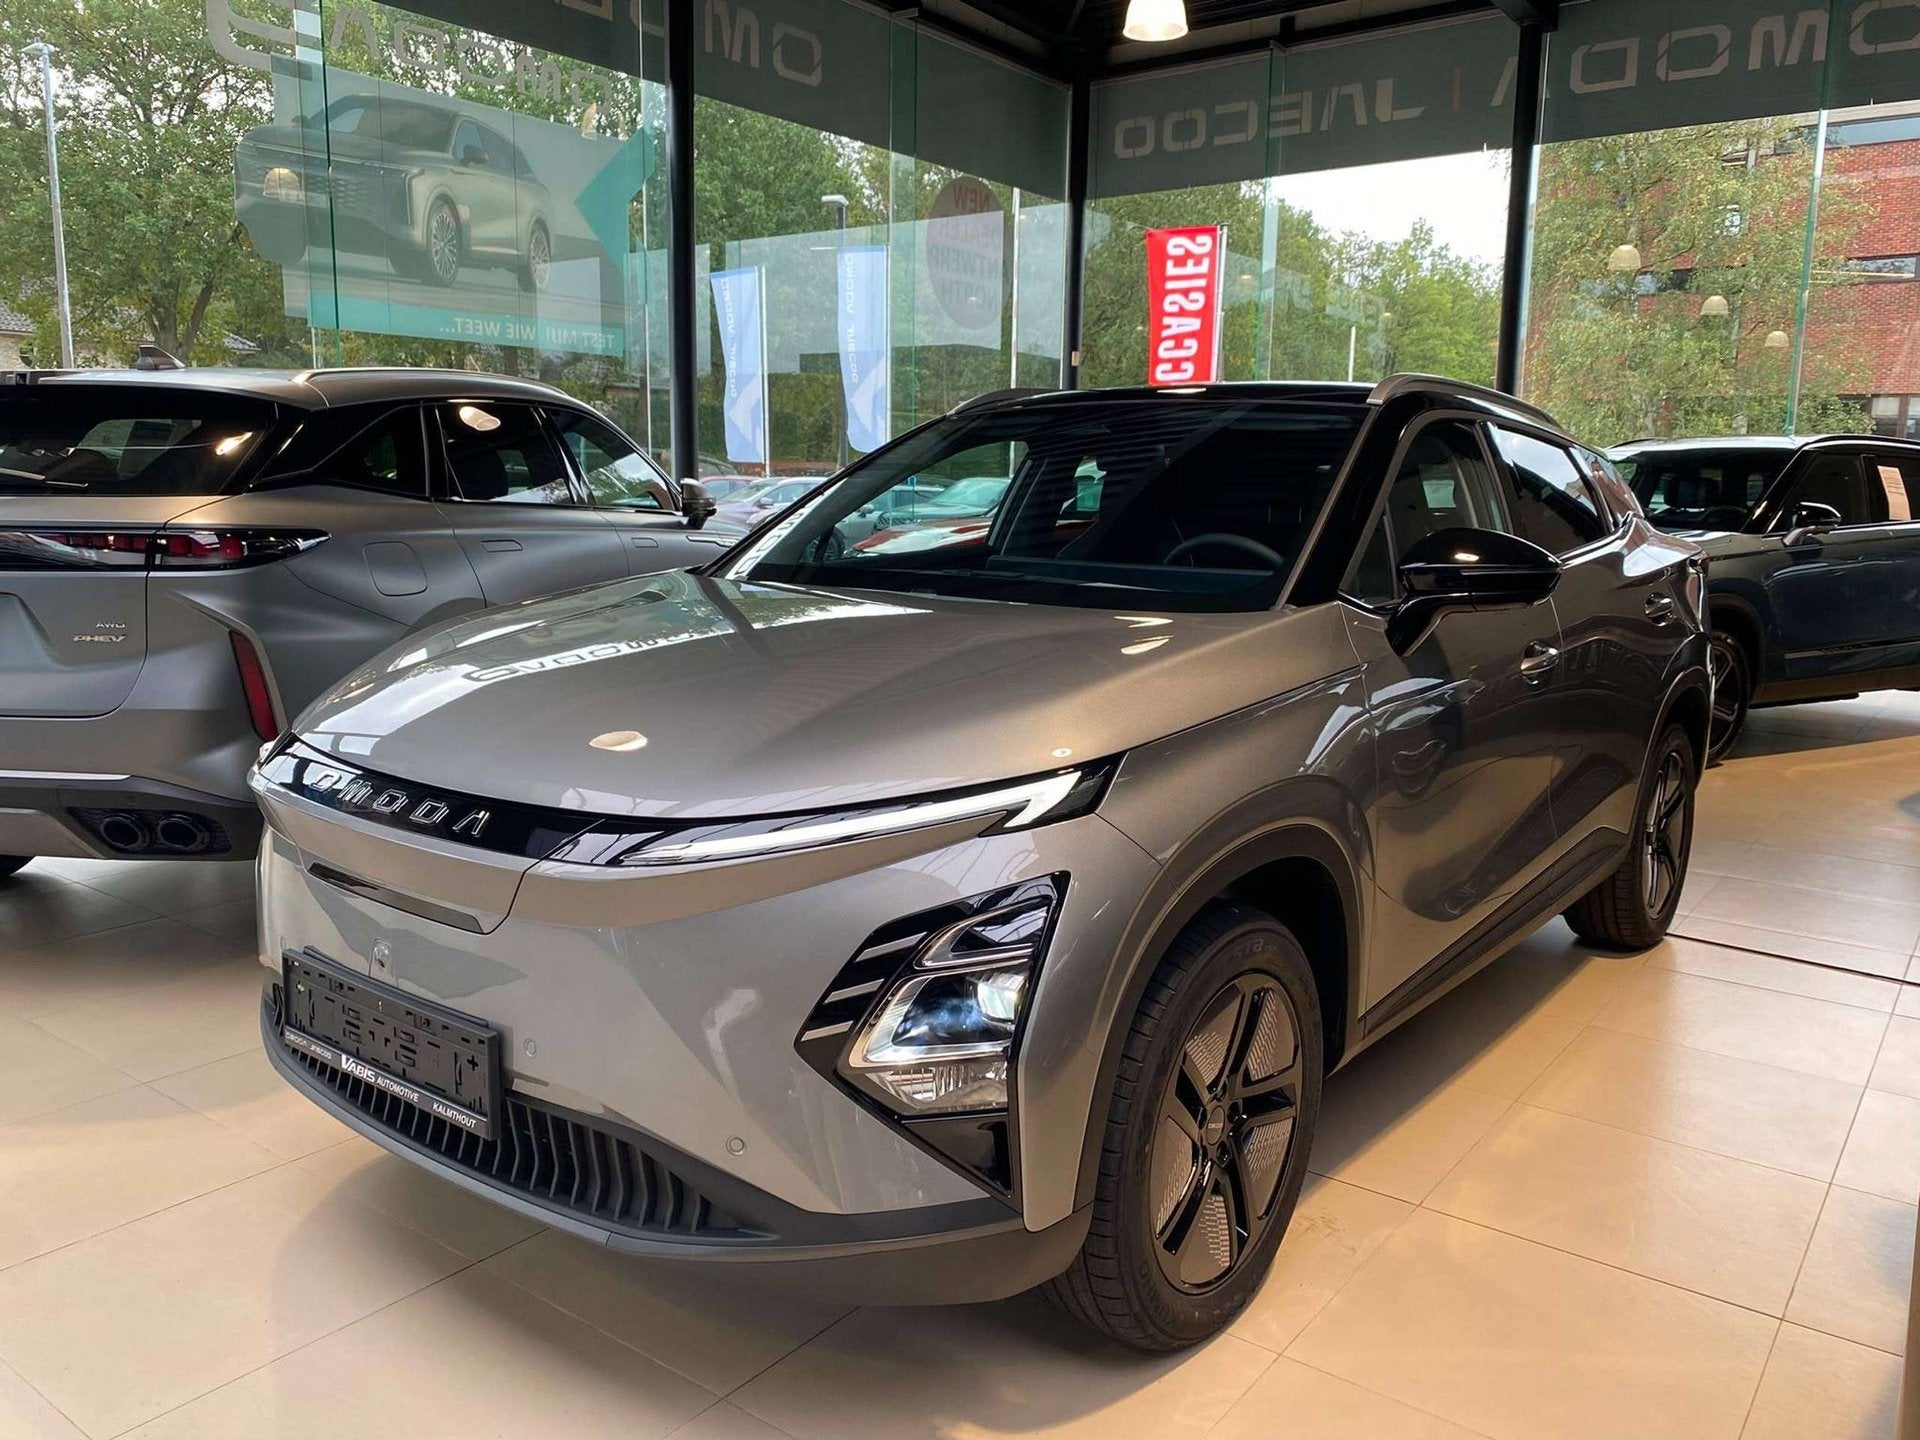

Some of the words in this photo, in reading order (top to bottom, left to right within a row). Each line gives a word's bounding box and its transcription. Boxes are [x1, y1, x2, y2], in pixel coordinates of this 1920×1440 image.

[309, 770, 491, 838] OMODA
[341, 1054, 376, 1083] VABIS
[376, 1076, 420, 1102] AUTOMOTIVE
[432, 1102, 477, 1128] KALMTHOUT
